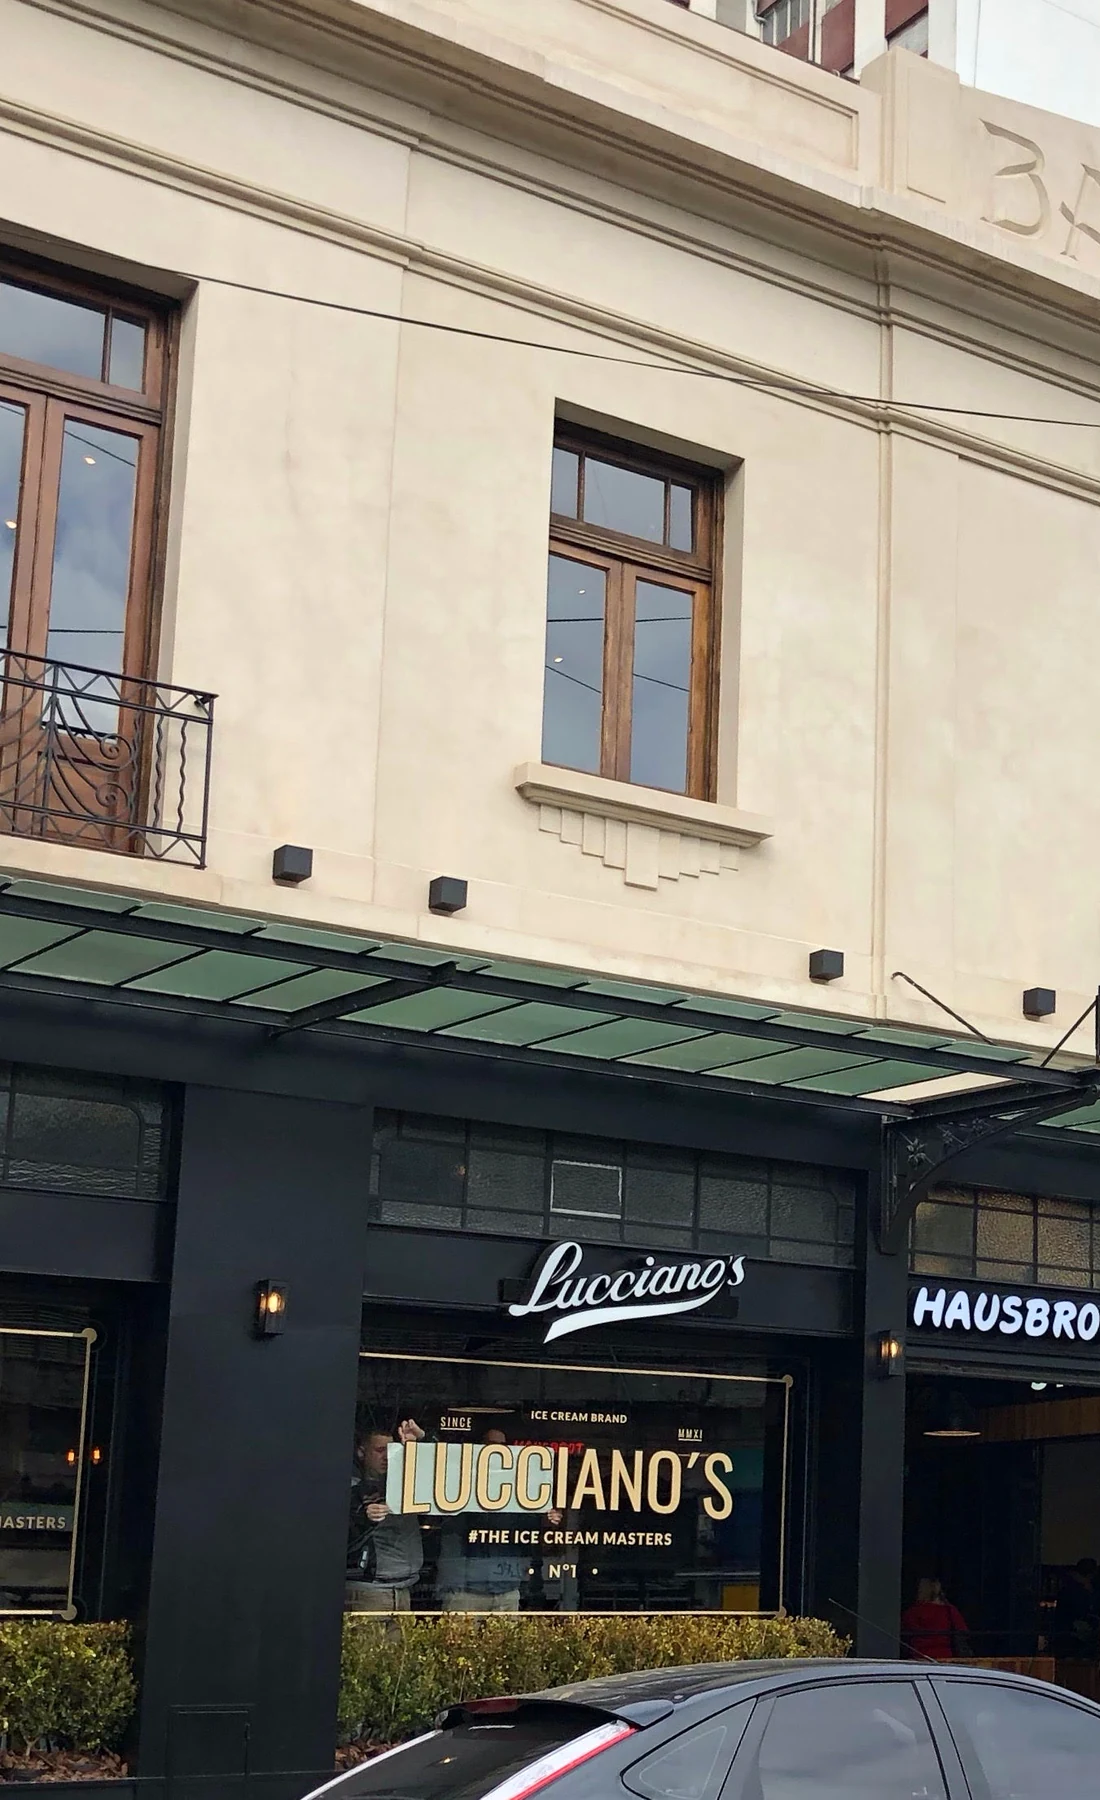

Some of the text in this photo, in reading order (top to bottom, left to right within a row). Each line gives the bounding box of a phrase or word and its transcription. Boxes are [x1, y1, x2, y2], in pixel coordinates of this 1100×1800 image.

[508, 1240, 747, 1317] Lucciano's
[440, 1416, 472, 1429] SINCE
[530, 1410, 628, 1424] ICE CREAM BRAND
[402, 1440, 734, 1520] LUCCIANO'S
[0, 1515, 66, 1529] ASTERS
[468, 1529, 672, 1546] #THE ICE CREAM MASTERS
